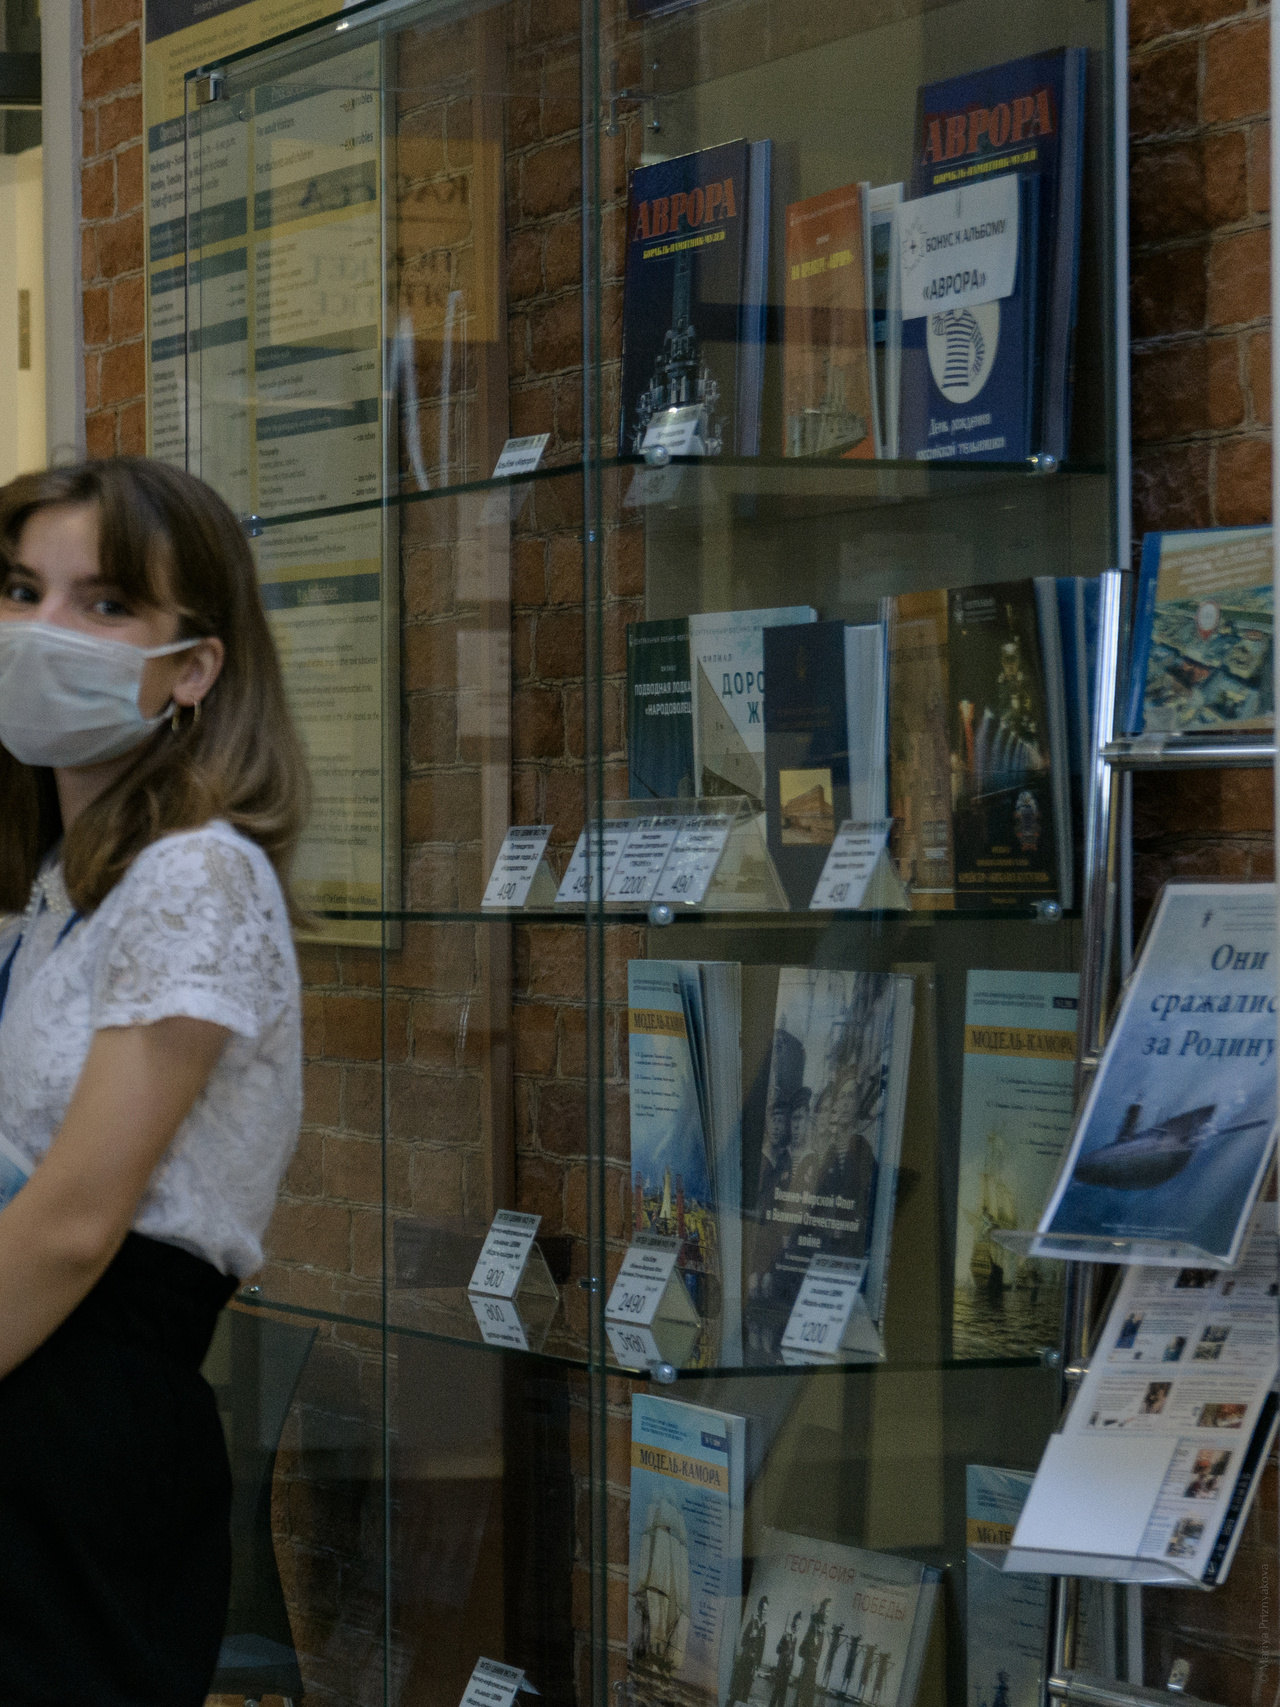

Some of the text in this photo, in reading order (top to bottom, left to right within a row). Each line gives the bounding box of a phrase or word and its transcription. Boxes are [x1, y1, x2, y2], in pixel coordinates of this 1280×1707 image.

[921, 90, 1053, 166] АВРОРА
[633, 178, 737, 242] АВРОРА
[926, 232, 954, 253] БОНУС
[963, 219, 1006, 243] АЛЬБОМУ
[923, 268, 986, 300] «АВРОРА»
[496, 883, 517, 901] 490
[619, 876, 647, 895] 2200
[671, 875, 694, 894] 490
[1211, 944, 1269, 971] Они
[1150, 994, 1277, 1021] сражалис
[1142, 1030, 1276, 1066] за Родину
[774, 1187, 856, 1211] Военно-Морской Флот
[772, 1208, 803, 1224] Великой
[803, 1212, 860, 1233] Отечественной
[798, 1233, 822, 1249] войне
[484, 1268, 506, 1289] 900
[617, 1292, 647, 1314] 2490
[800, 1321, 829, 1345] 1200
[639, 1448, 722, 1487] МОДЕЛЬ-КАМОРА
[784, 1554, 857, 1585] ГЕОГРАФИЯ
[851, 1591, 907, 1622] ПОБЕДЫ
